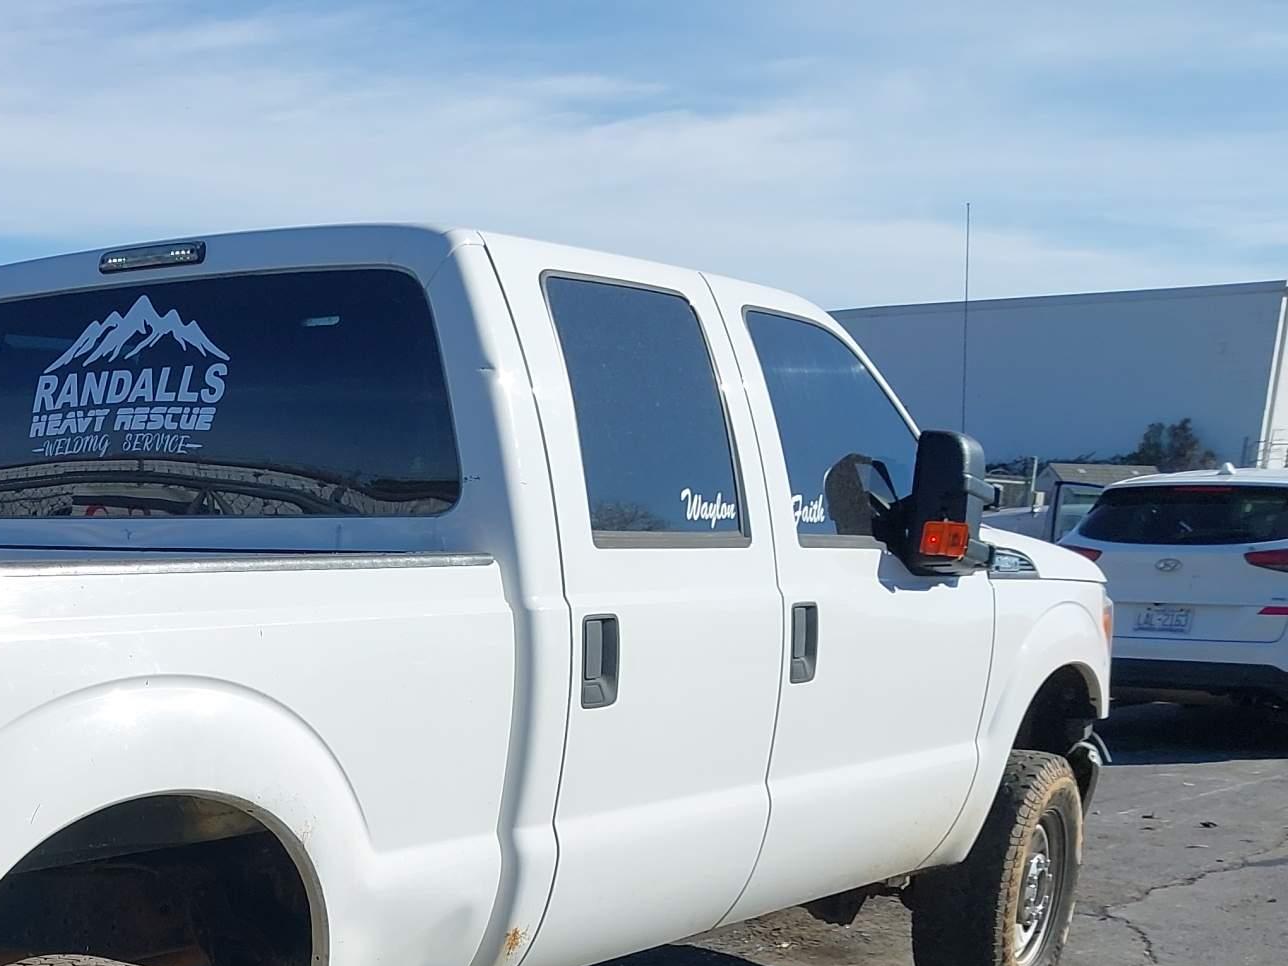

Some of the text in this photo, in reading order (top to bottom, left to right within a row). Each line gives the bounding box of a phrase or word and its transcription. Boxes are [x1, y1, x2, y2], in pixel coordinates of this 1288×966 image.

[32, 362, 229, 414] RANDALLS
[29, 406, 217, 438] HEAVY RESCUE
[42, 432, 191, 458] WELDING SERVICE
[680, 487, 736, 529] Waylon
